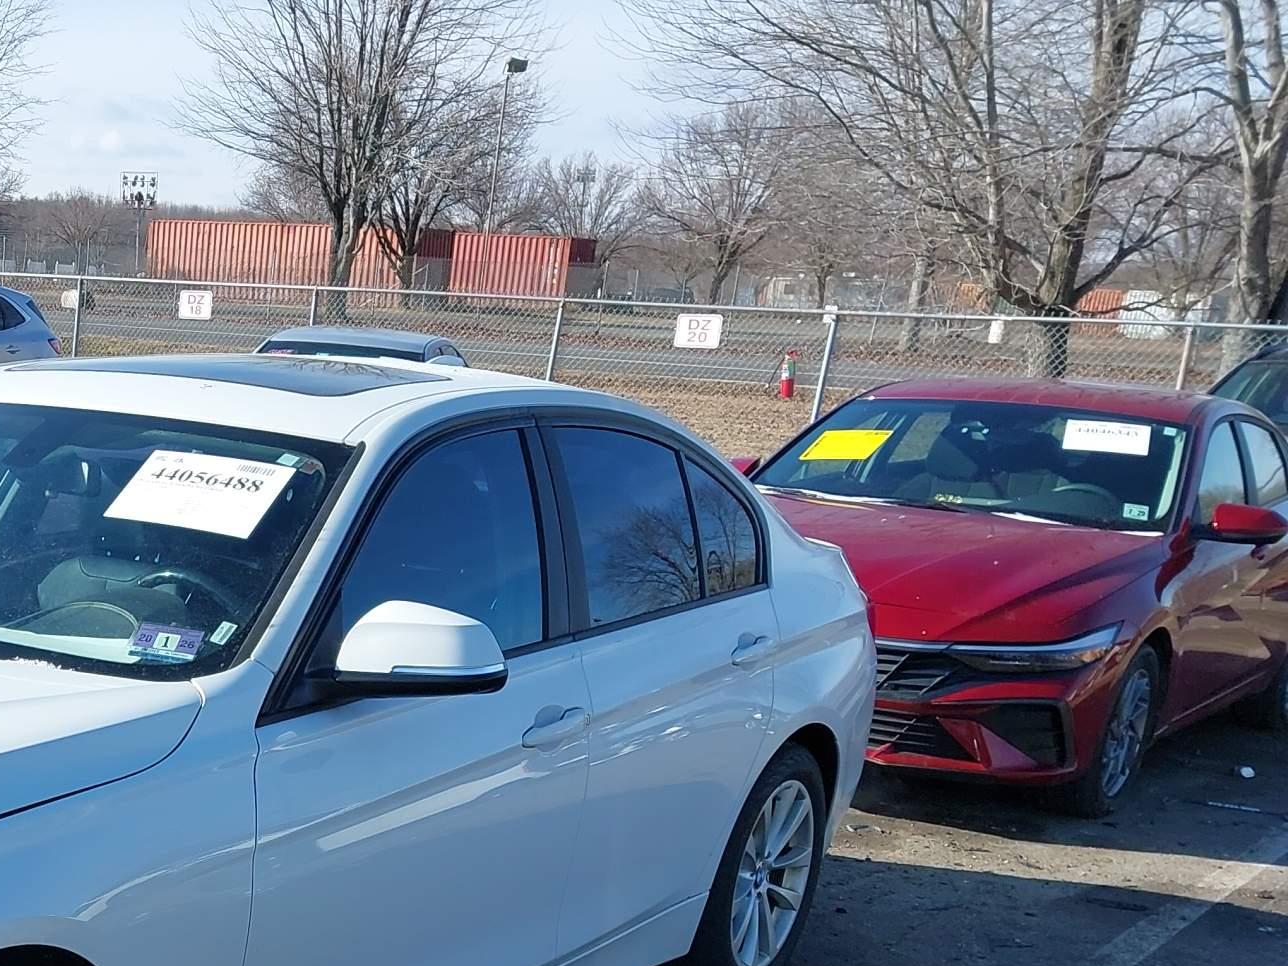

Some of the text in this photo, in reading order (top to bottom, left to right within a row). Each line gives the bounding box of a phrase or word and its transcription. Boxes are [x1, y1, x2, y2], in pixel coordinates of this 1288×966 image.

[187, 294, 205, 305] DZ
[190, 305, 202, 315] 18
[688, 319, 712, 331] DZ
[687, 331, 707, 343] 20
[151, 467, 264, 493] 44056488
[138, 633, 195, 650] 20 1 26
